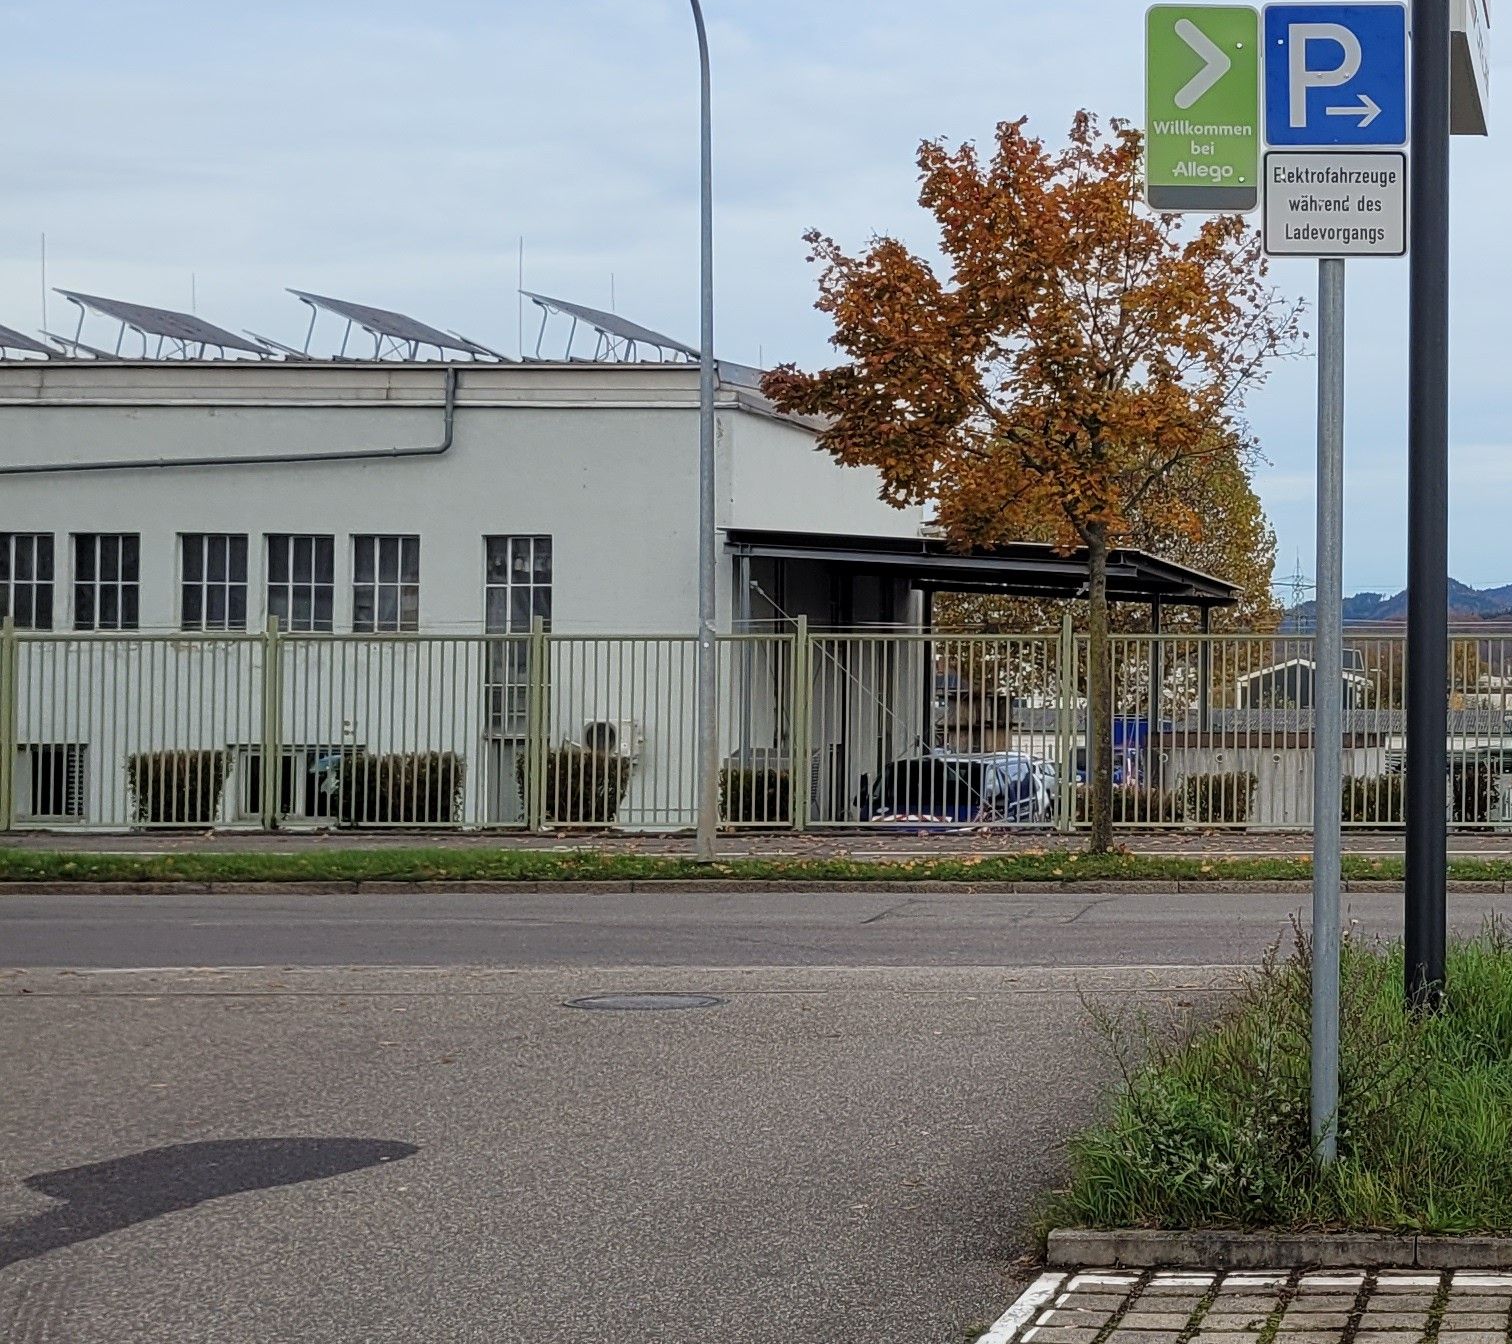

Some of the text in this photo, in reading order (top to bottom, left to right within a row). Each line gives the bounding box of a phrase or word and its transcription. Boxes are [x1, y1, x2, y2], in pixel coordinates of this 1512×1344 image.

[1288, 23, 1362, 128] P
[1153, 120, 1252, 136] Willkommen
[1190, 140, 1215, 156] bei
[1172, 161, 1234, 182] Allego
[1273, 166, 1397, 188] Elektrofahrzeuge
[1288, 194, 1382, 212] während des
[1285, 223, 1385, 244] Ladevorgangs
